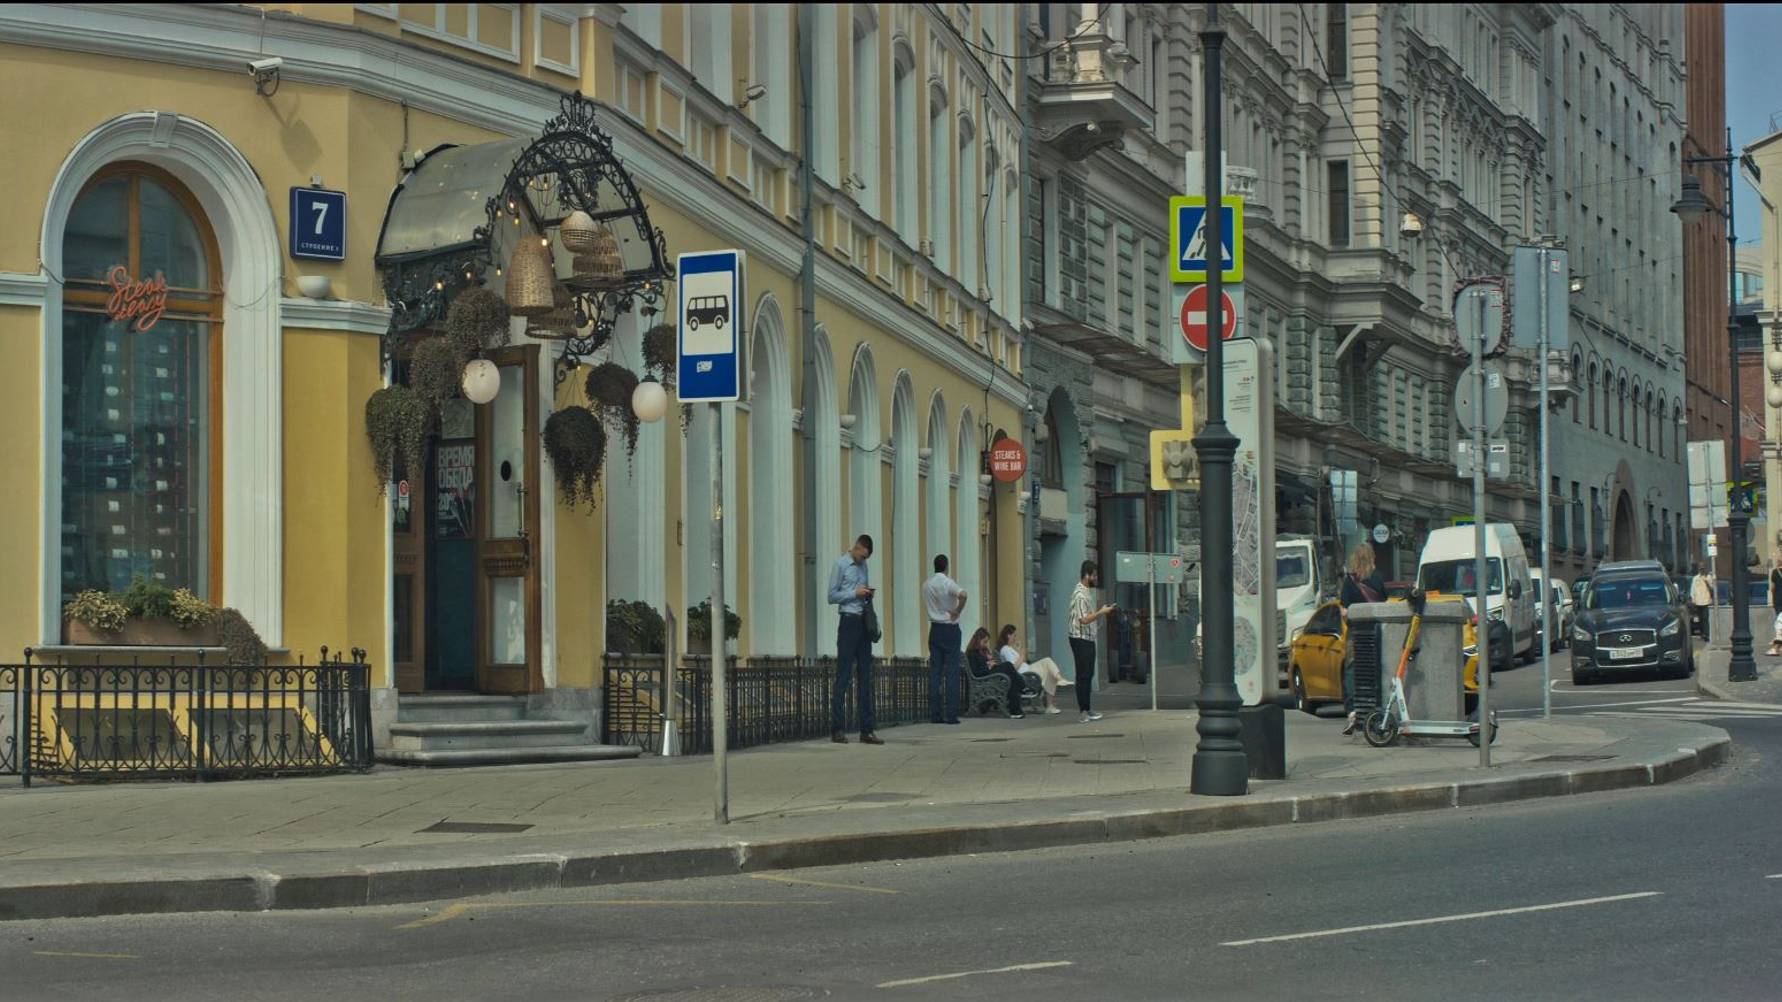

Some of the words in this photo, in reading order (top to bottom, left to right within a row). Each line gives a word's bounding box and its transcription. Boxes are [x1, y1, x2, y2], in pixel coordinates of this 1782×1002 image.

[312, 202, 329, 235] 7
[301, 242, 334, 252] СТРОЕНИЕ
[438, 446, 475, 467] ВРЕМЯ
[994, 450, 1016, 460] STEAKS
[994, 461, 1009, 471] WINE
[438, 467, 473, 490] ОБЕДА
